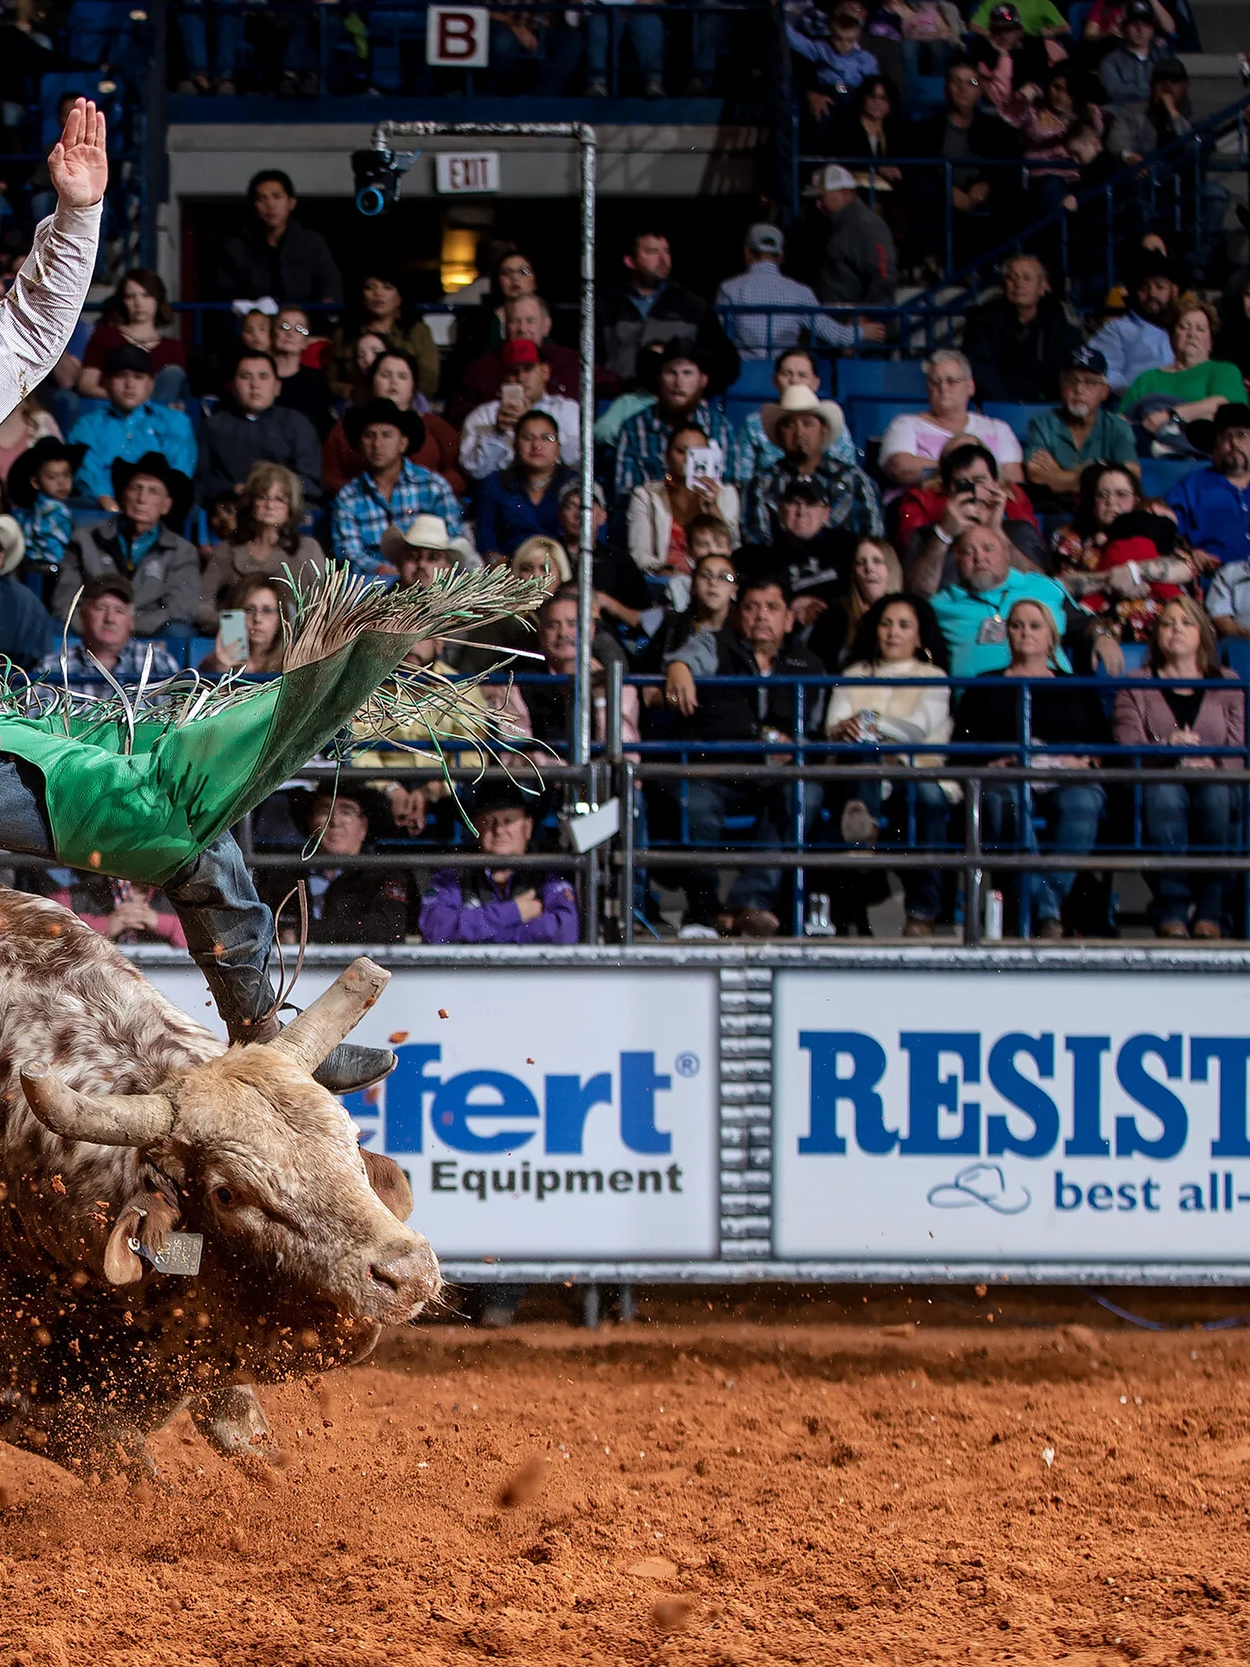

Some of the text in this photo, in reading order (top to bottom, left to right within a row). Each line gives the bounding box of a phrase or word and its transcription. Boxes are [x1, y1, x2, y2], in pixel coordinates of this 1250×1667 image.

[437, 12, 476, 60] B
[449, 157, 488, 190] EXIT
[797, 1028, 1250, 1161] RESIST
[430, 1160, 684, 1200] Equipment
[1054, 1170, 1161, 1213] best
